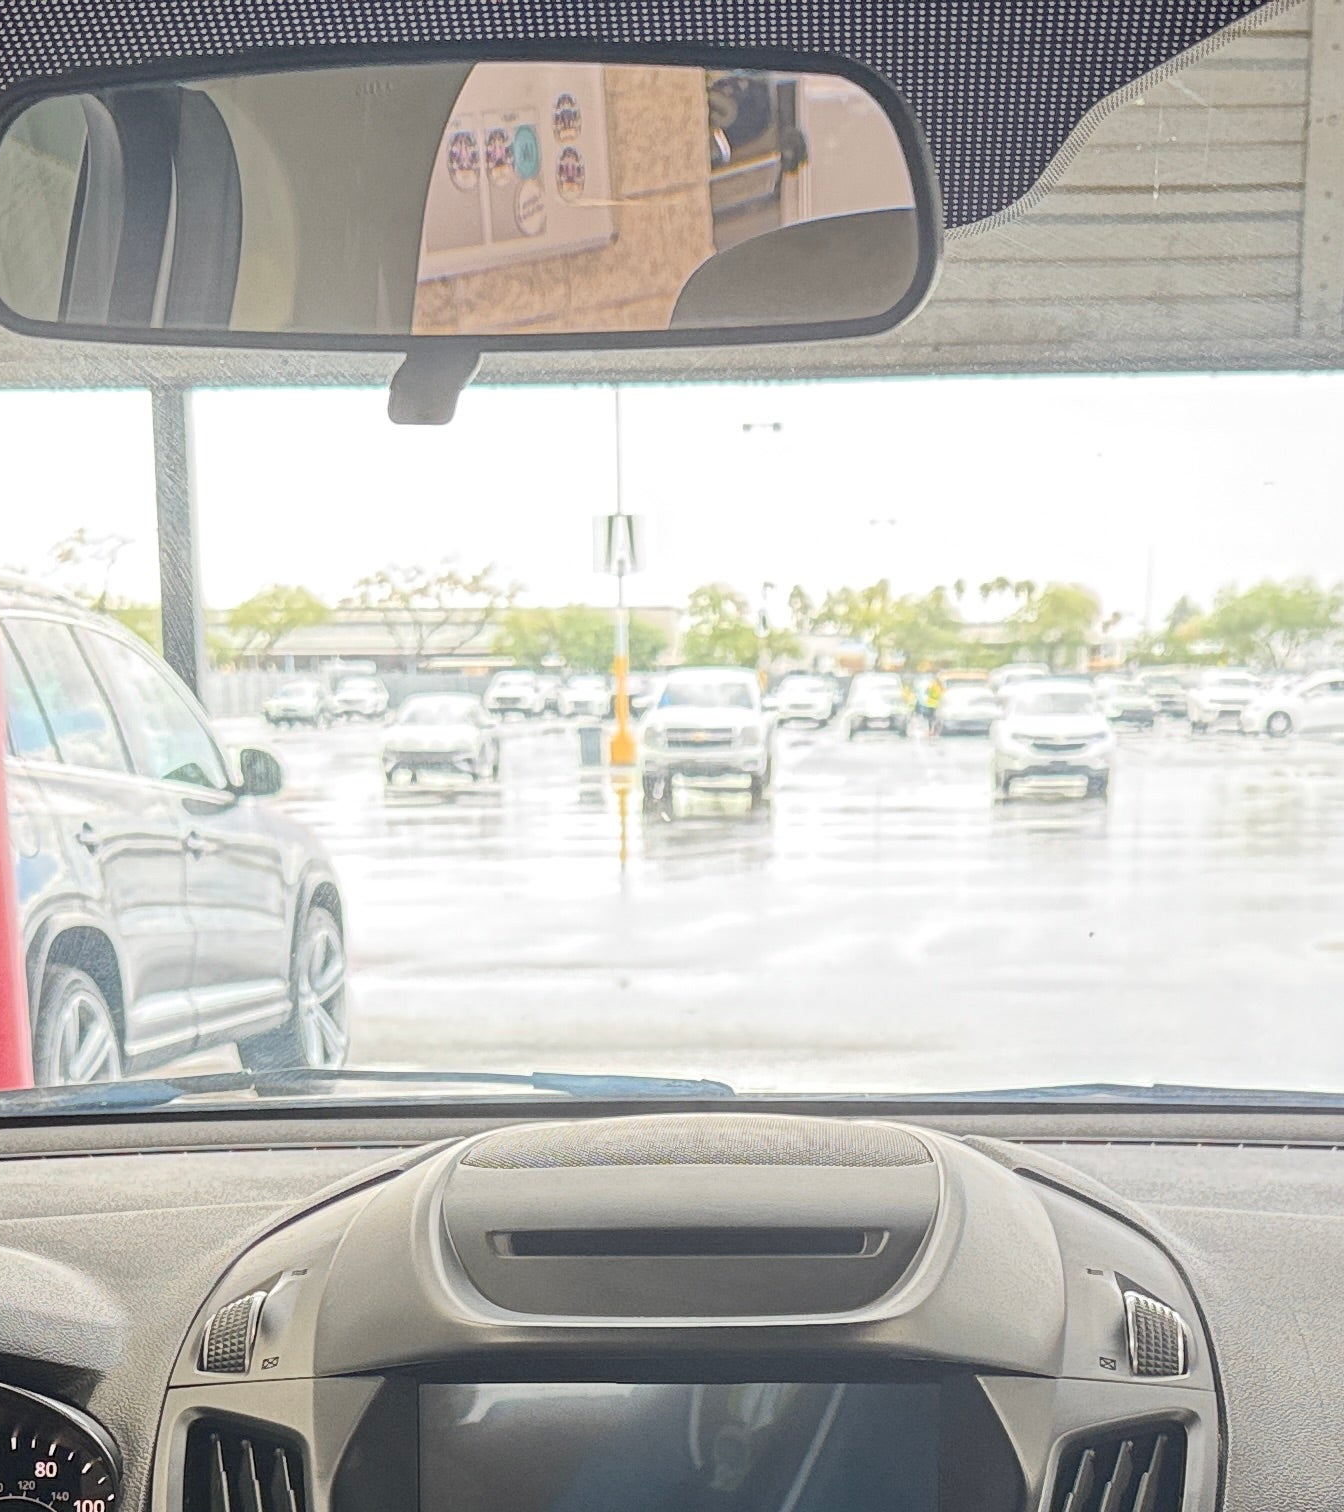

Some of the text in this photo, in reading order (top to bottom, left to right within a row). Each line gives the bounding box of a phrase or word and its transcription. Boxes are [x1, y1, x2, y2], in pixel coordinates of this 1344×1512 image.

[35, 1461, 57, 1478] 80
[17, 1480, 36, 1491] 120
[51, 1491, 69, 1502] 140
